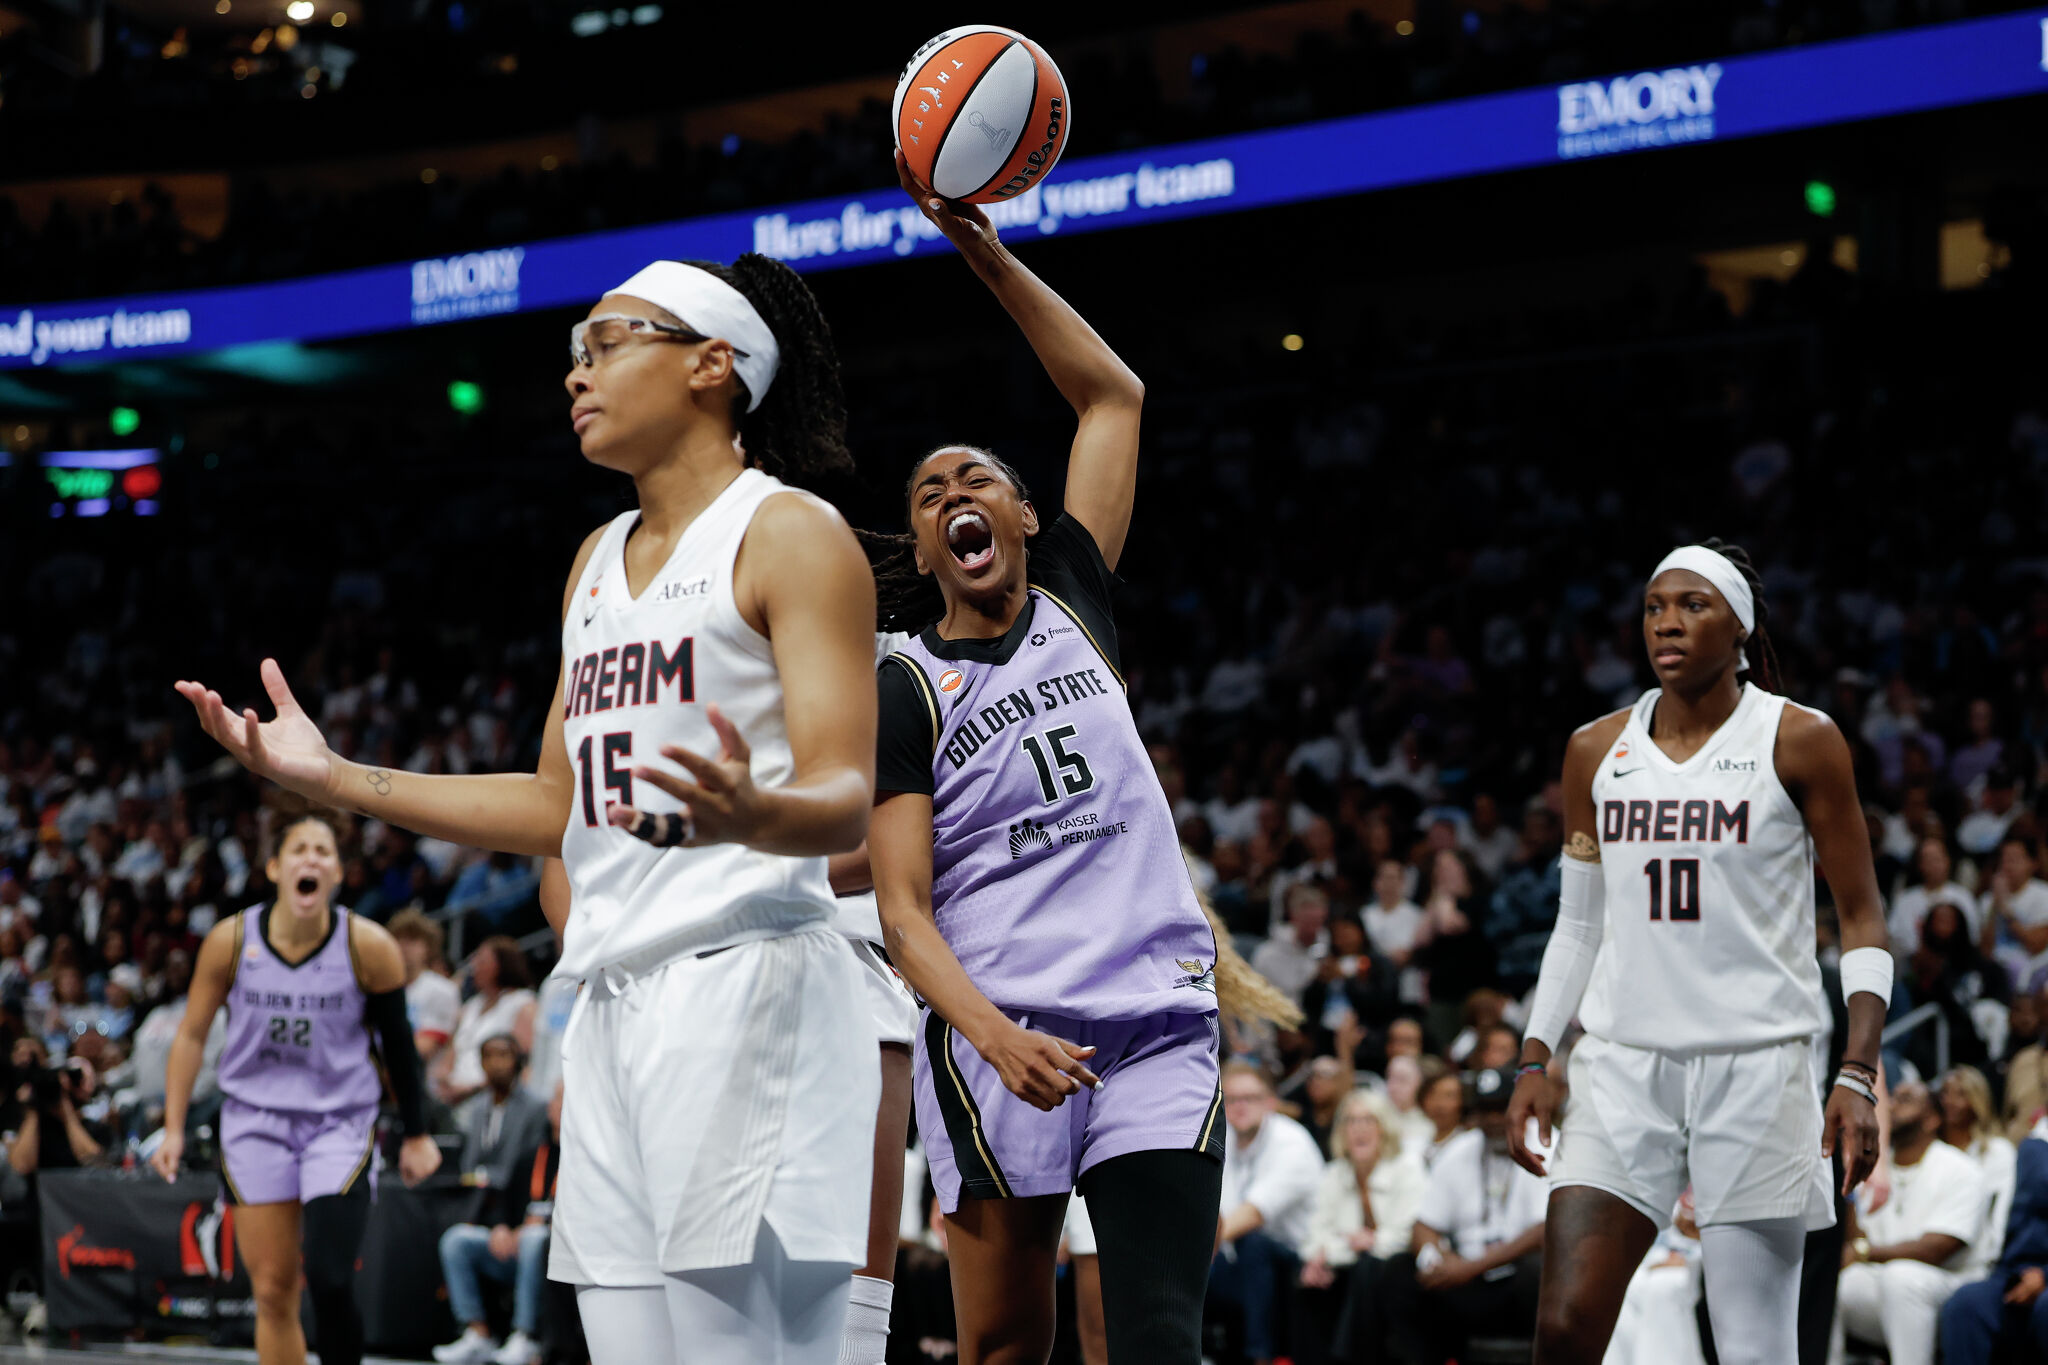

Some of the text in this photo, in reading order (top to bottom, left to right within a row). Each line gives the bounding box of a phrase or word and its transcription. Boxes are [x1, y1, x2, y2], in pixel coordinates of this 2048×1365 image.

[1557, 63, 1723, 134] EMORY
[990, 97, 1062, 197] Wilson
[1038, 172, 1137, 234] your
[1136, 161, 1235, 208] team
[411, 246, 525, 304] EMORY
[656, 578, 707, 600] Albert
[1048, 627, 1075, 639] freedom
[943, 668, 1108, 771] GOLDEN STATE
[577, 731, 633, 828] 15
[1020, 722, 1096, 806] 15
[1712, 759, 1755, 772] Albert
[1056, 813, 1099, 831] KAISER
[1061, 821, 1128, 846] PERMANENTE
[1603, 800, 1749, 844] DREAM
[1644, 858, 1701, 921] 10
[270, 1016, 311, 1048] 22
